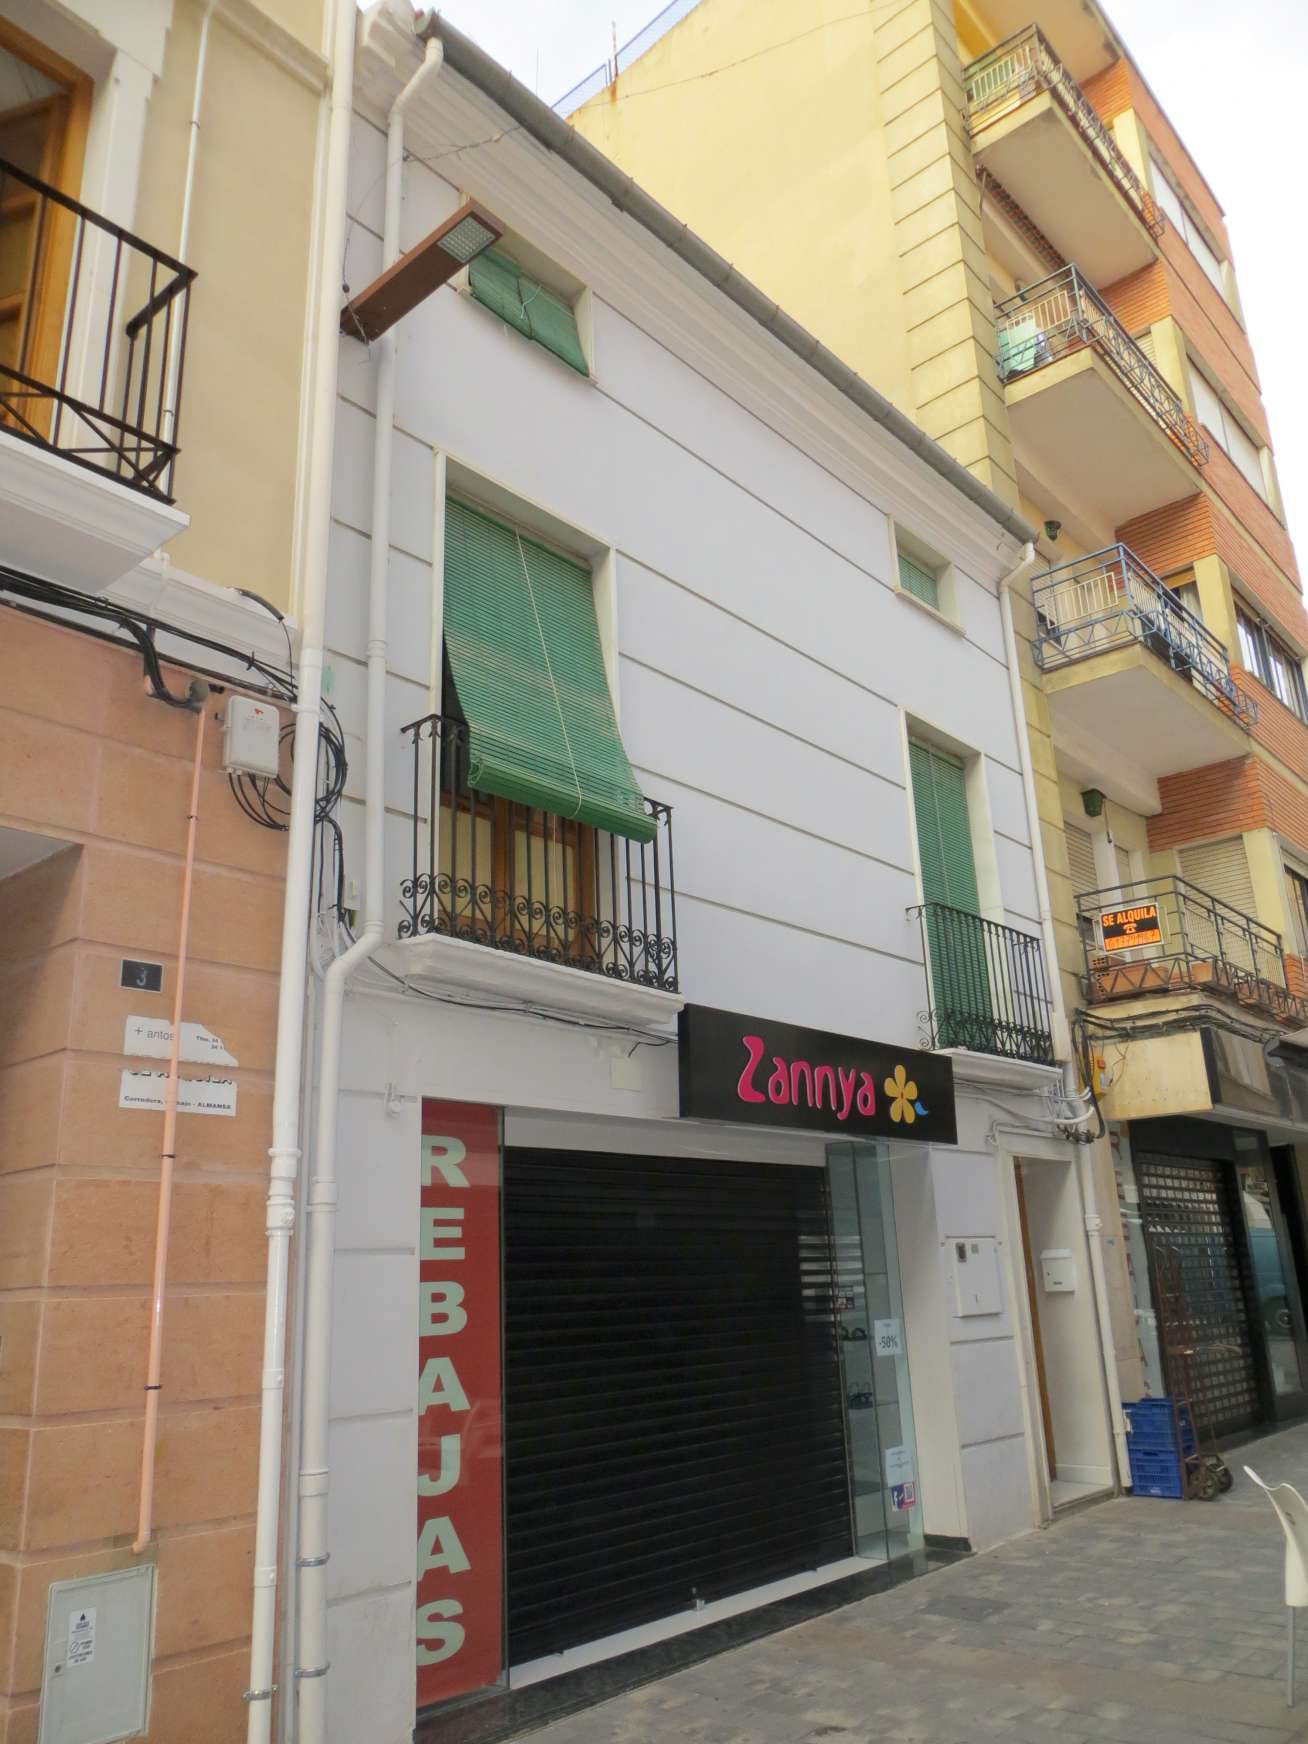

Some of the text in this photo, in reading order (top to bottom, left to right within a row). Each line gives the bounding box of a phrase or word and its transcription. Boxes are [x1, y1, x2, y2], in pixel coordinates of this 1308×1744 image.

[1102, 906, 1156, 926] SE ALQUILA
[136, 967, 148, 986] 3
[737, 1035, 876, 1121] Zannya
[416, 1134, 471, 1667] REBAJAS
